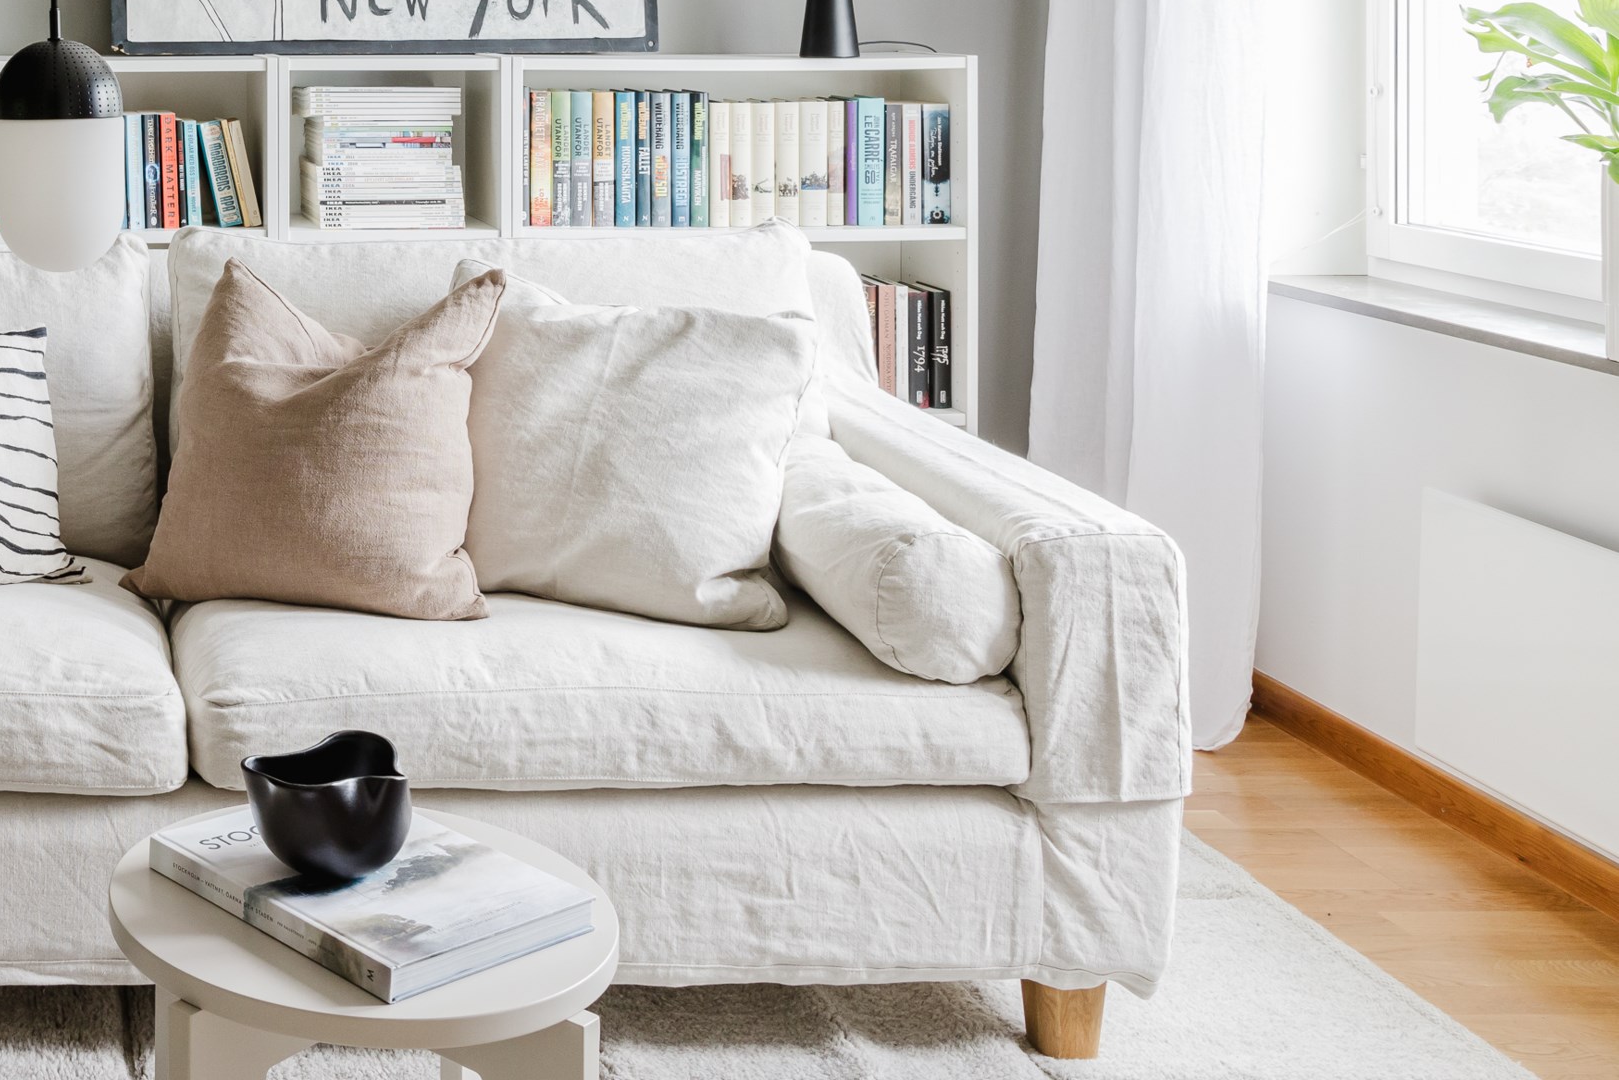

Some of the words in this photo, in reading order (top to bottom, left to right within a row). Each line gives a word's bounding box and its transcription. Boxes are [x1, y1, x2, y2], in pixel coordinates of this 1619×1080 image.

[165, 117, 173, 152] DARK
[535, 97, 546, 141] PRATCHETT
[864, 116, 872, 128] LE
[596, 118, 604, 158] UTANFÖR
[864, 129, 883, 162] CARRÉ
[621, 145, 633, 204] KUNGSHJÄRTA
[638, 147, 650, 176] FALLET
[865, 170, 876, 184] 60
[888, 140, 898, 183] TRAFALGAR
[166, 164, 176, 218] MATTER
[675, 156, 688, 207] HÖSTREGN
[694, 170, 702, 206] MARVIKEN
[909, 171, 918, 209] UNDERGÅNG
[912, 346, 926, 373] 1794
[930, 345, 949, 366] 1795
[172, 862, 200, 881] STOCKHOLM
[225, 891, 242, 905] ÖARNA
[255, 906, 274, 922] STADEN
